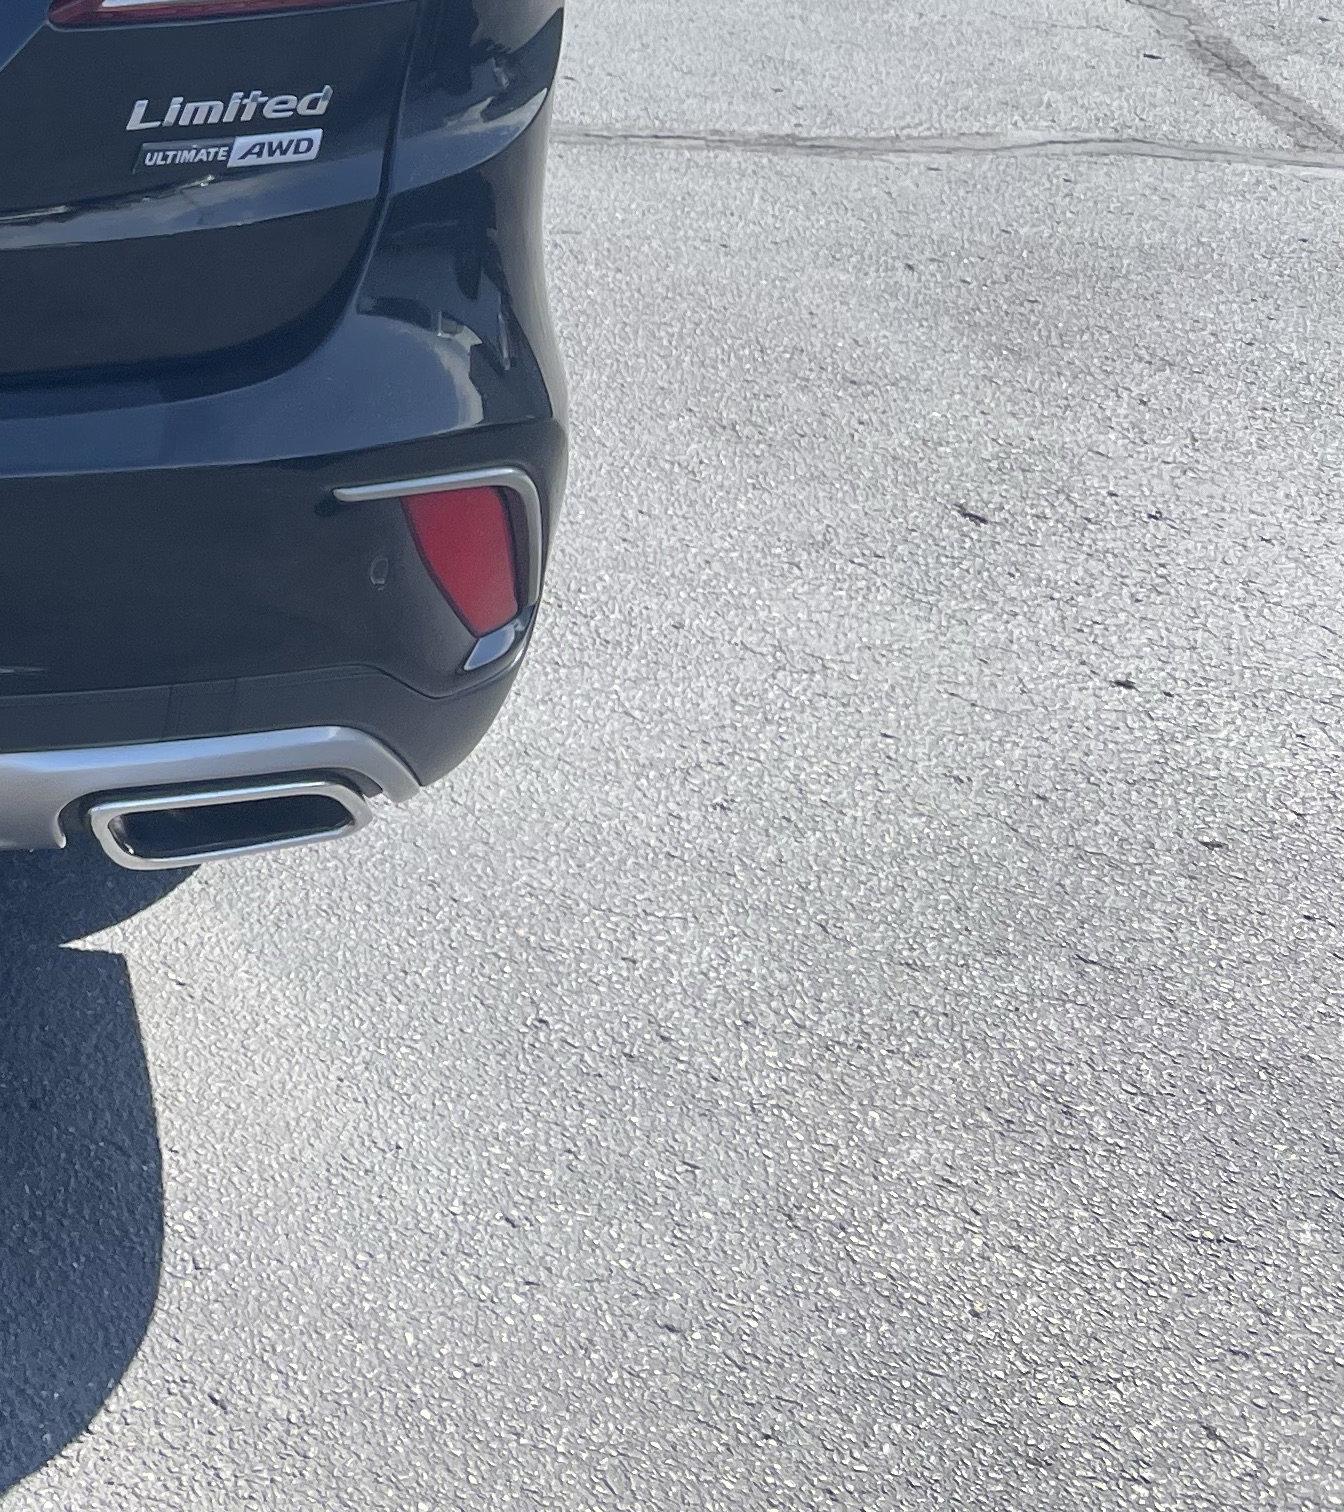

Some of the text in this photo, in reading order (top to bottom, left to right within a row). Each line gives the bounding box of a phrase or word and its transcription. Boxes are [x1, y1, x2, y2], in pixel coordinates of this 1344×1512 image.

[126, 85, 334, 131] Limited
[144, 137, 314, 167] ULTIMATE AWD
